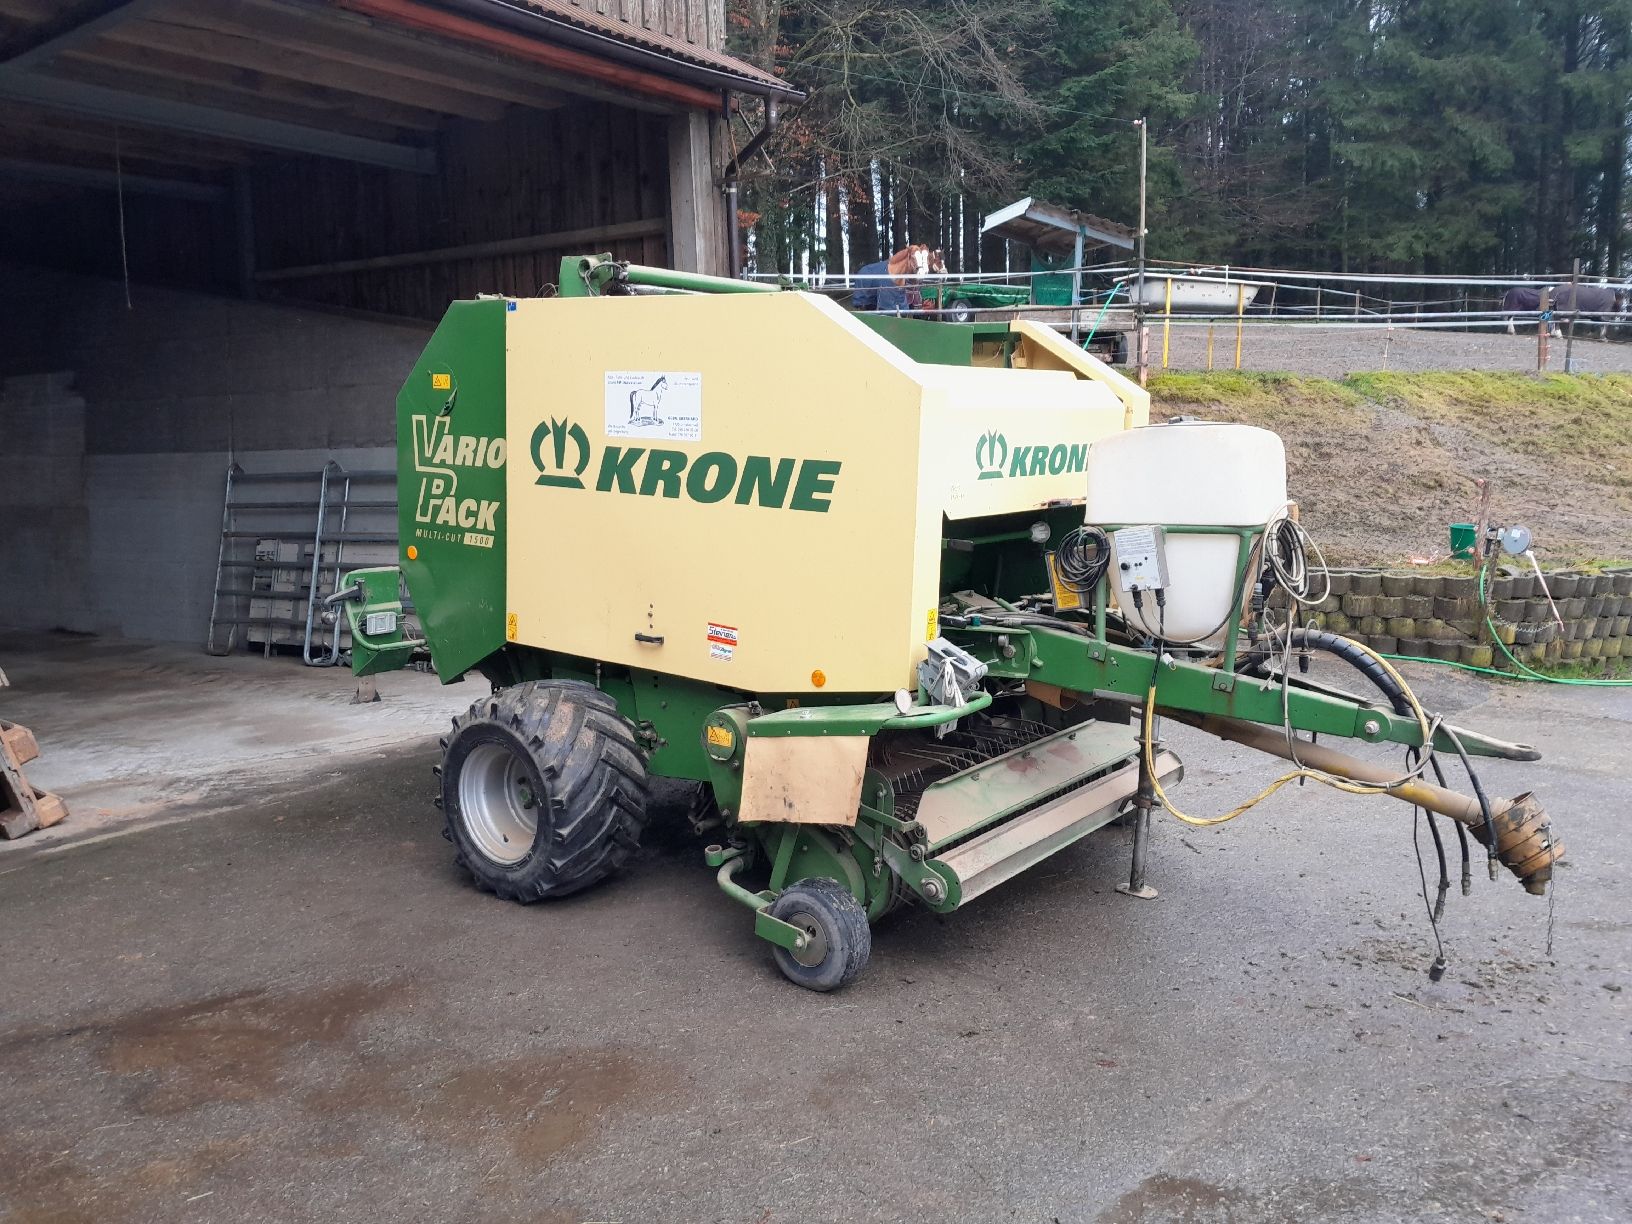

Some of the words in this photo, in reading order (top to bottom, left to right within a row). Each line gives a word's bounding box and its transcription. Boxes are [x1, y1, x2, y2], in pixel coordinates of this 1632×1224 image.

[412, 414, 507, 471] VARIO
[1008, 443, 1093, 478] KRON
[416, 466, 501, 531] PACK
[595, 445, 843, 513] KRONE
[415, 528, 462, 543] MULTI-CUT
